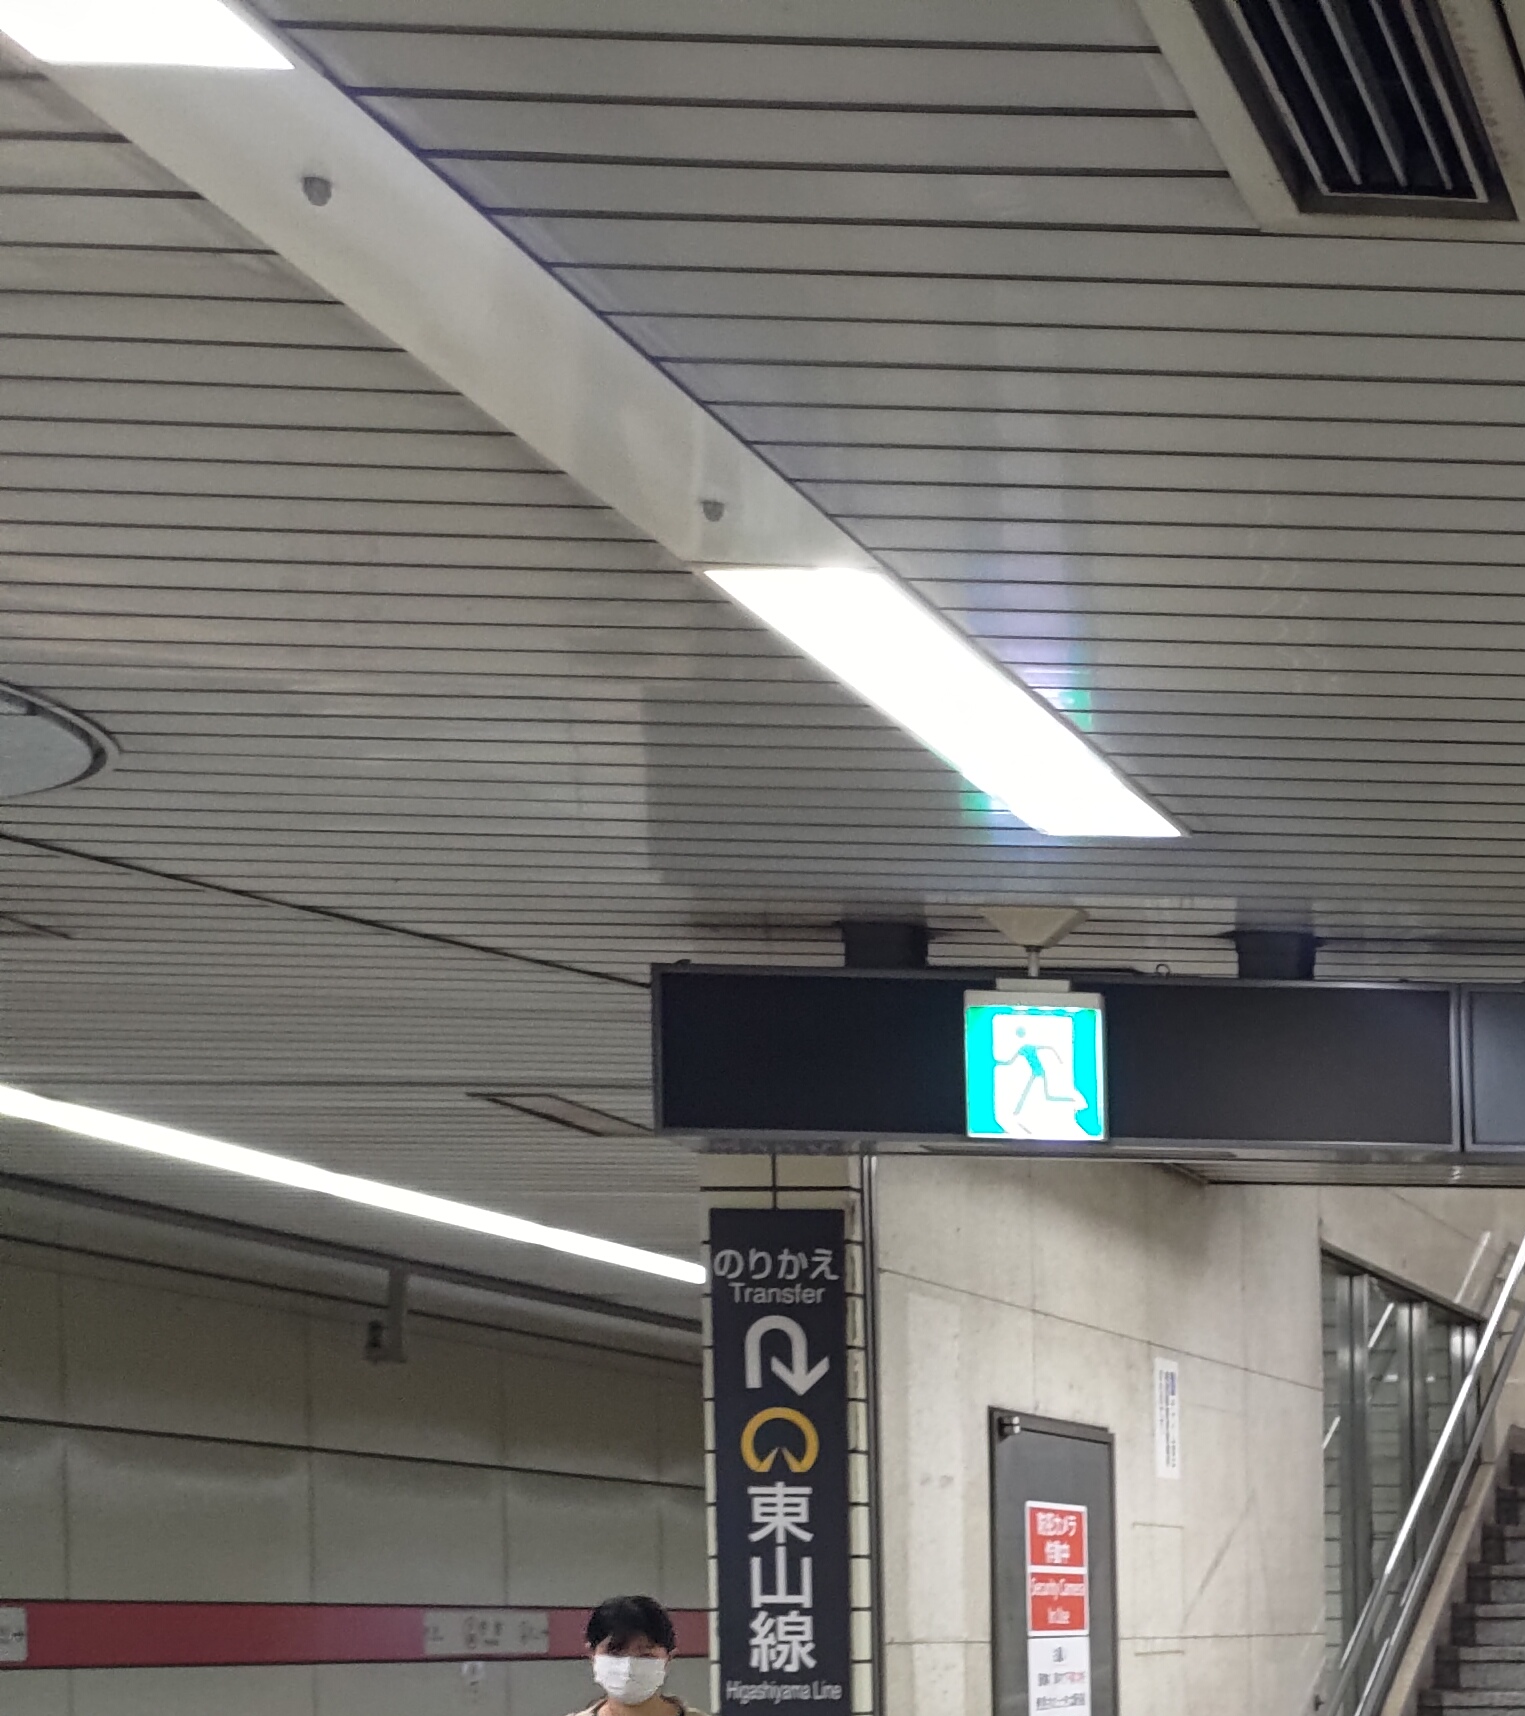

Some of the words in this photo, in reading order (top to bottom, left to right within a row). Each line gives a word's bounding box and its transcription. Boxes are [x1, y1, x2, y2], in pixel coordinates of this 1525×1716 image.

[713, 1248, 840, 1281] のりかえ
[727, 1282, 826, 1304] Transfer
[747, 1481, 817, 1673] 東山線
[725, 1680, 811, 1705] Higashiyama
[812, 1681, 843, 1700] Line
